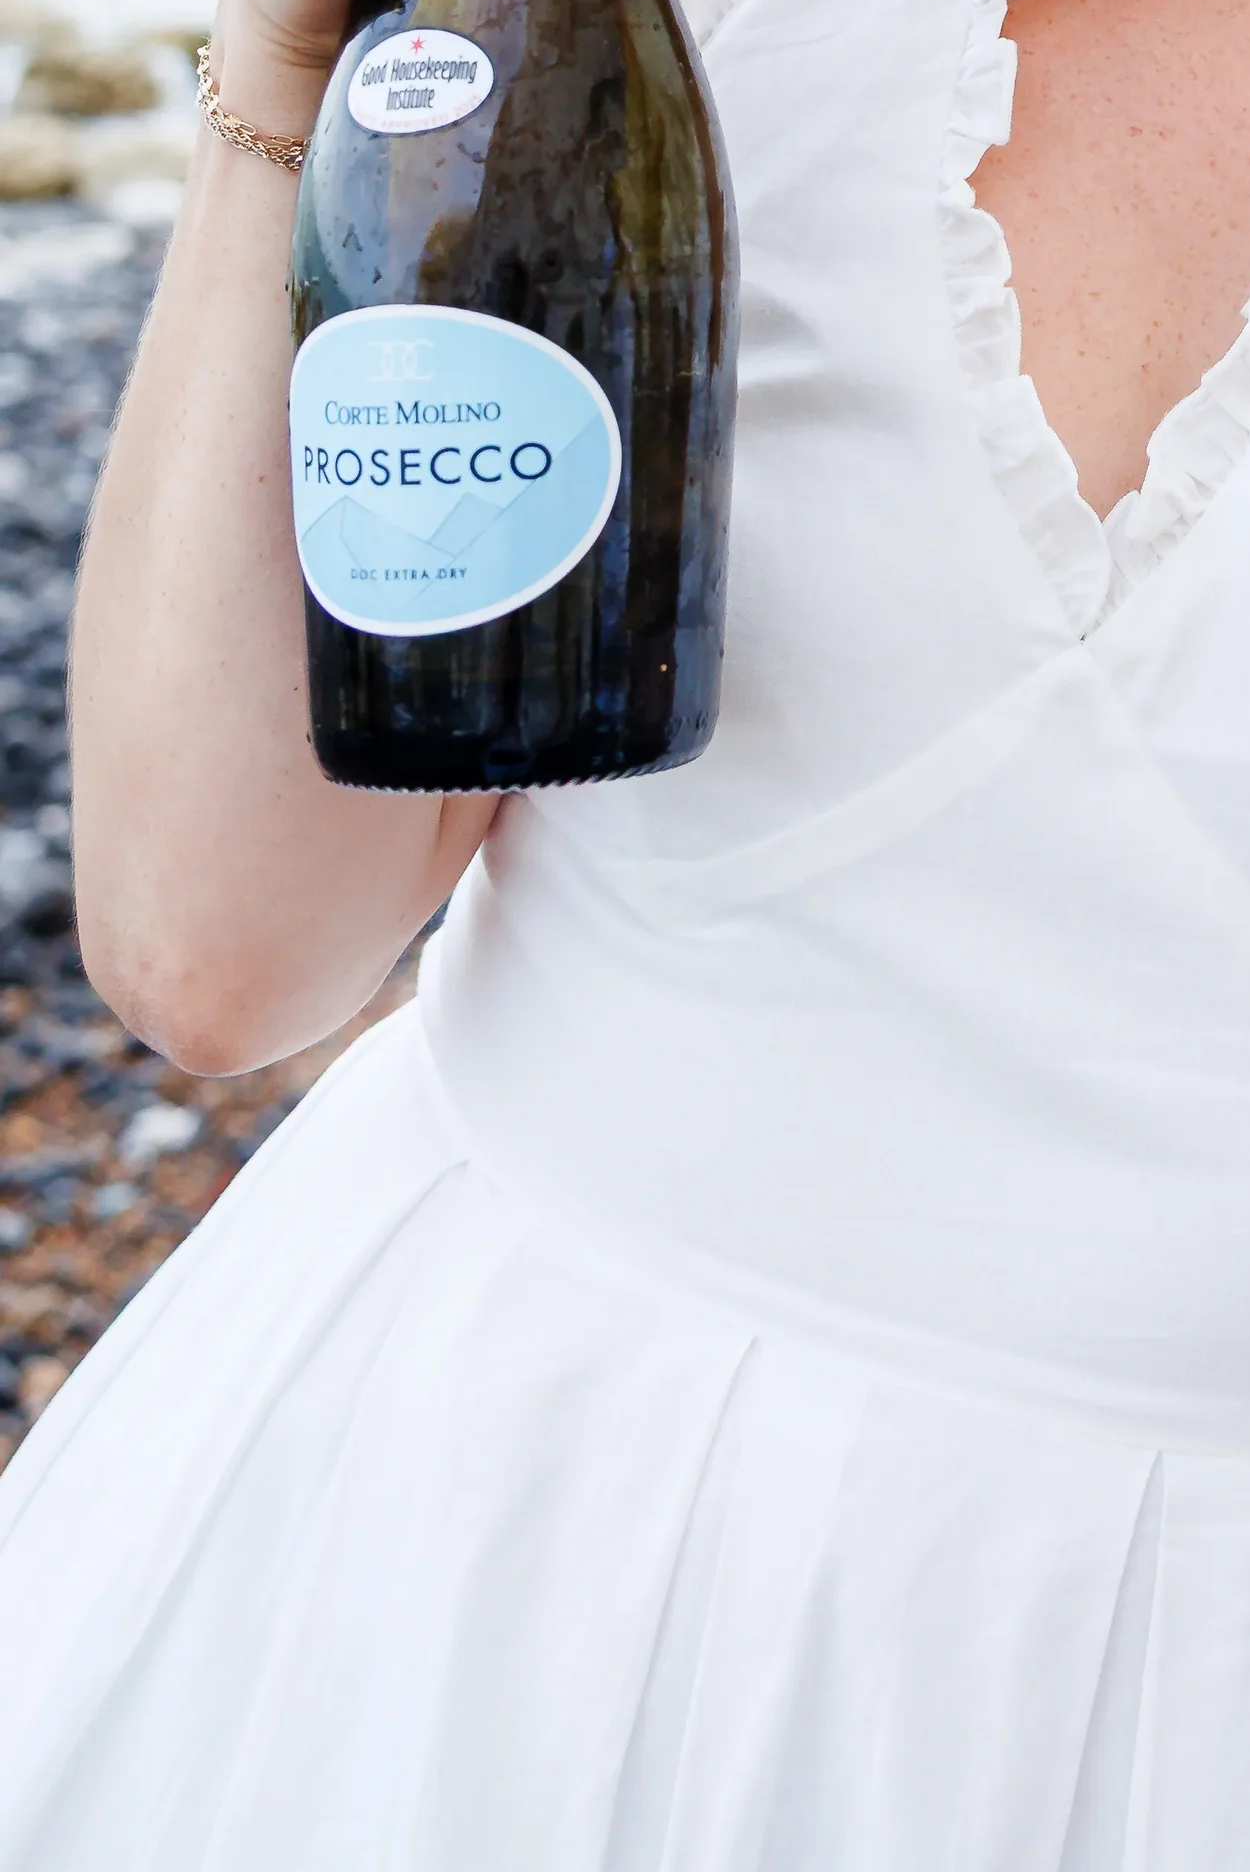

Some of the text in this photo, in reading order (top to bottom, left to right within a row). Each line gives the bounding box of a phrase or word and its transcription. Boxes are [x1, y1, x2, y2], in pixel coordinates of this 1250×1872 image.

[362, 55, 478, 86] Good Housekeeping
[387, 85, 435, 111] Institute
[325, 400, 501, 426] CORTE MOLINO
[304, 442, 553, 486] PROSECCO
[350, 567, 468, 581] DOC EXTRA DRY
